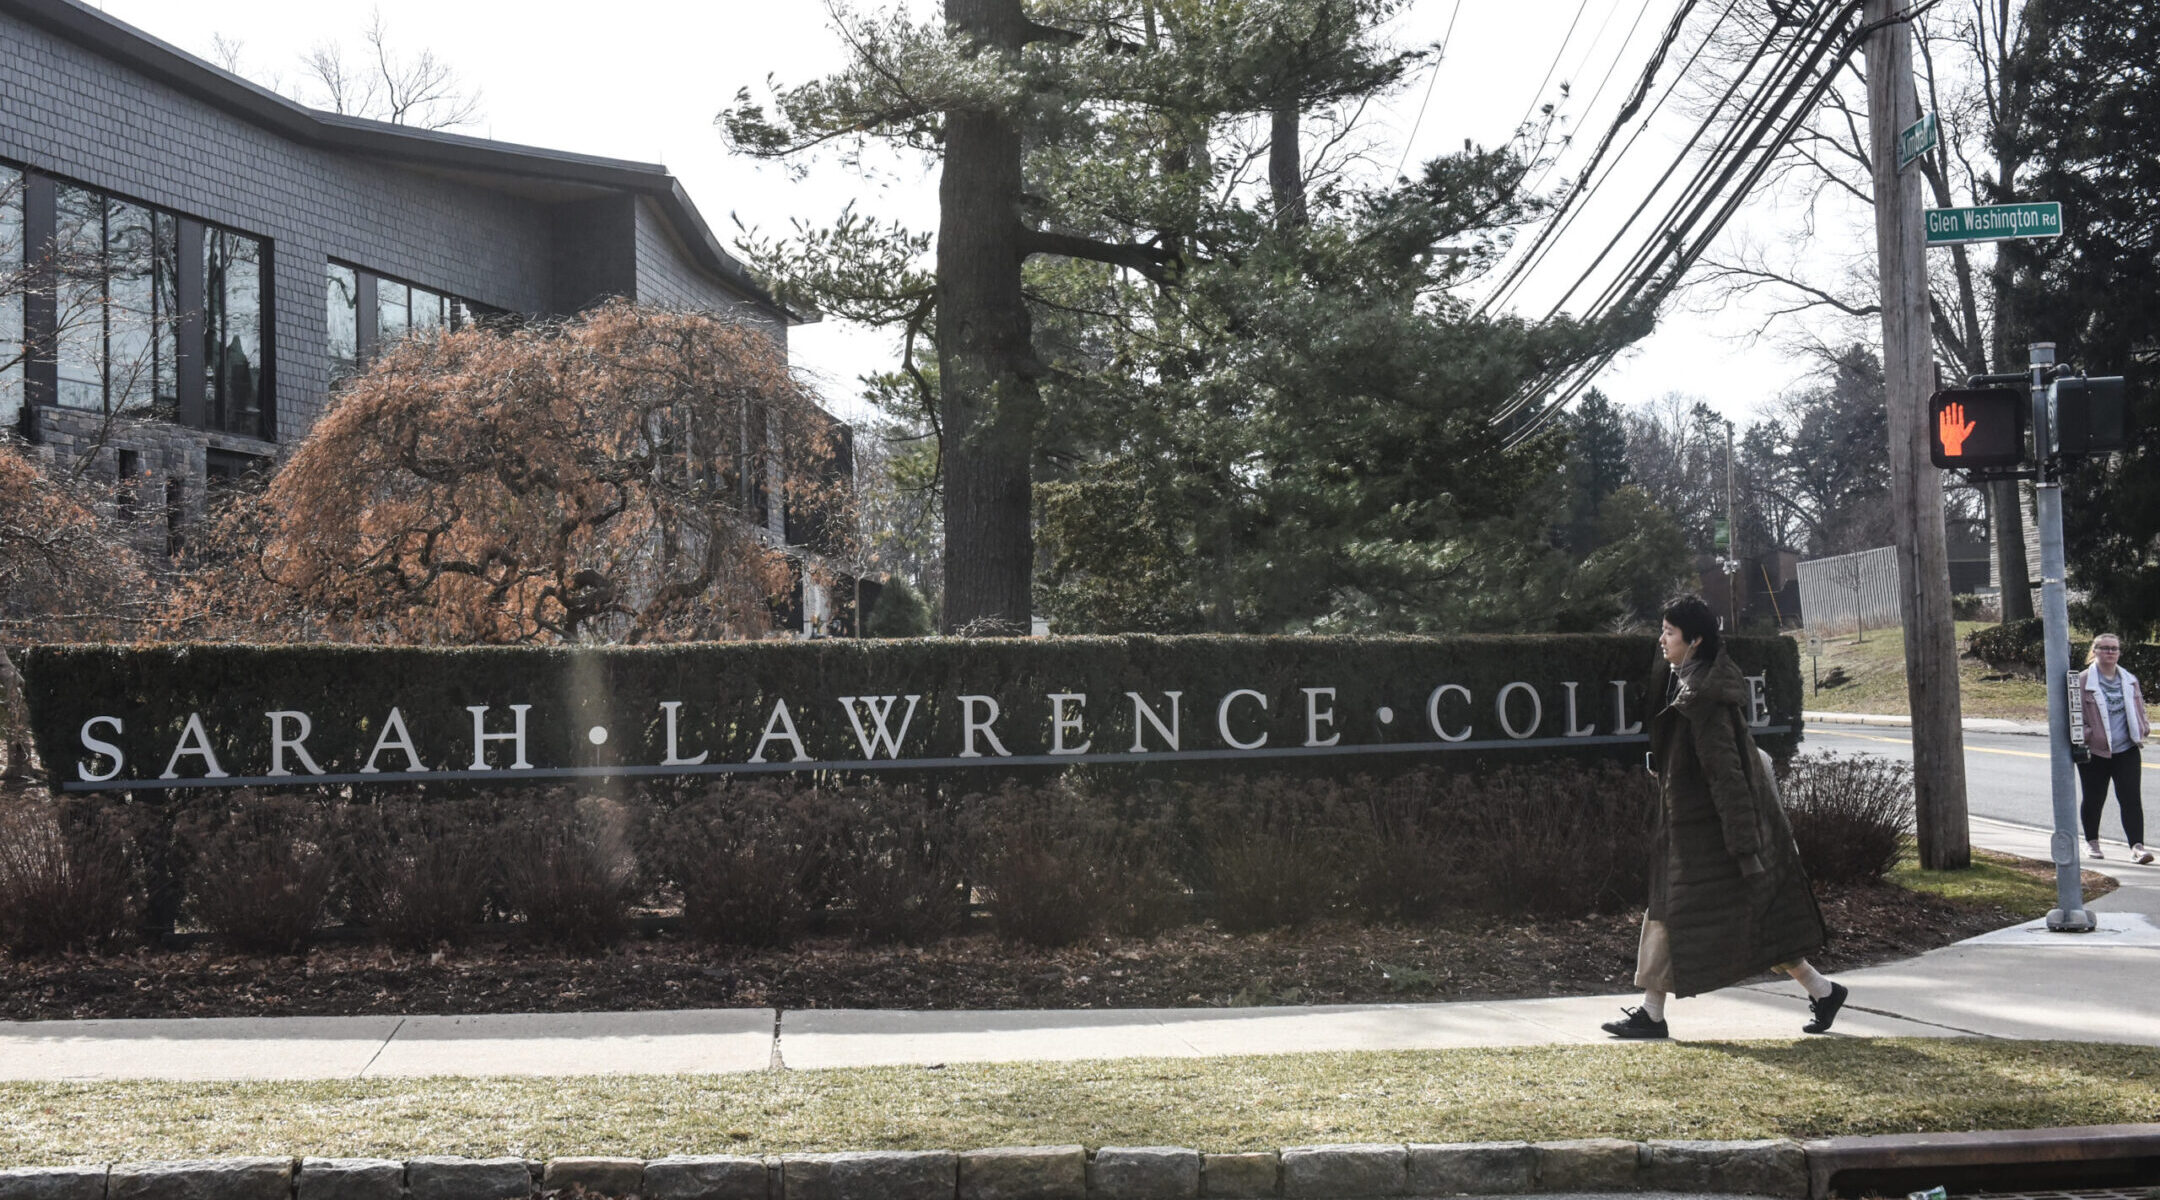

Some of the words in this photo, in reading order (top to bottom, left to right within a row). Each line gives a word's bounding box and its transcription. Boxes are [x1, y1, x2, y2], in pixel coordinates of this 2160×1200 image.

[1929, 211, 1959, 233] Glen
[1963, 207, 2039, 235] Washington
[2042, 213, 2057, 226] Rd
[78, 704, 534, 782] SARAH
[659, 687, 1342, 767] LAWRENCE
[1426, 675, 1771, 742] COLLE
